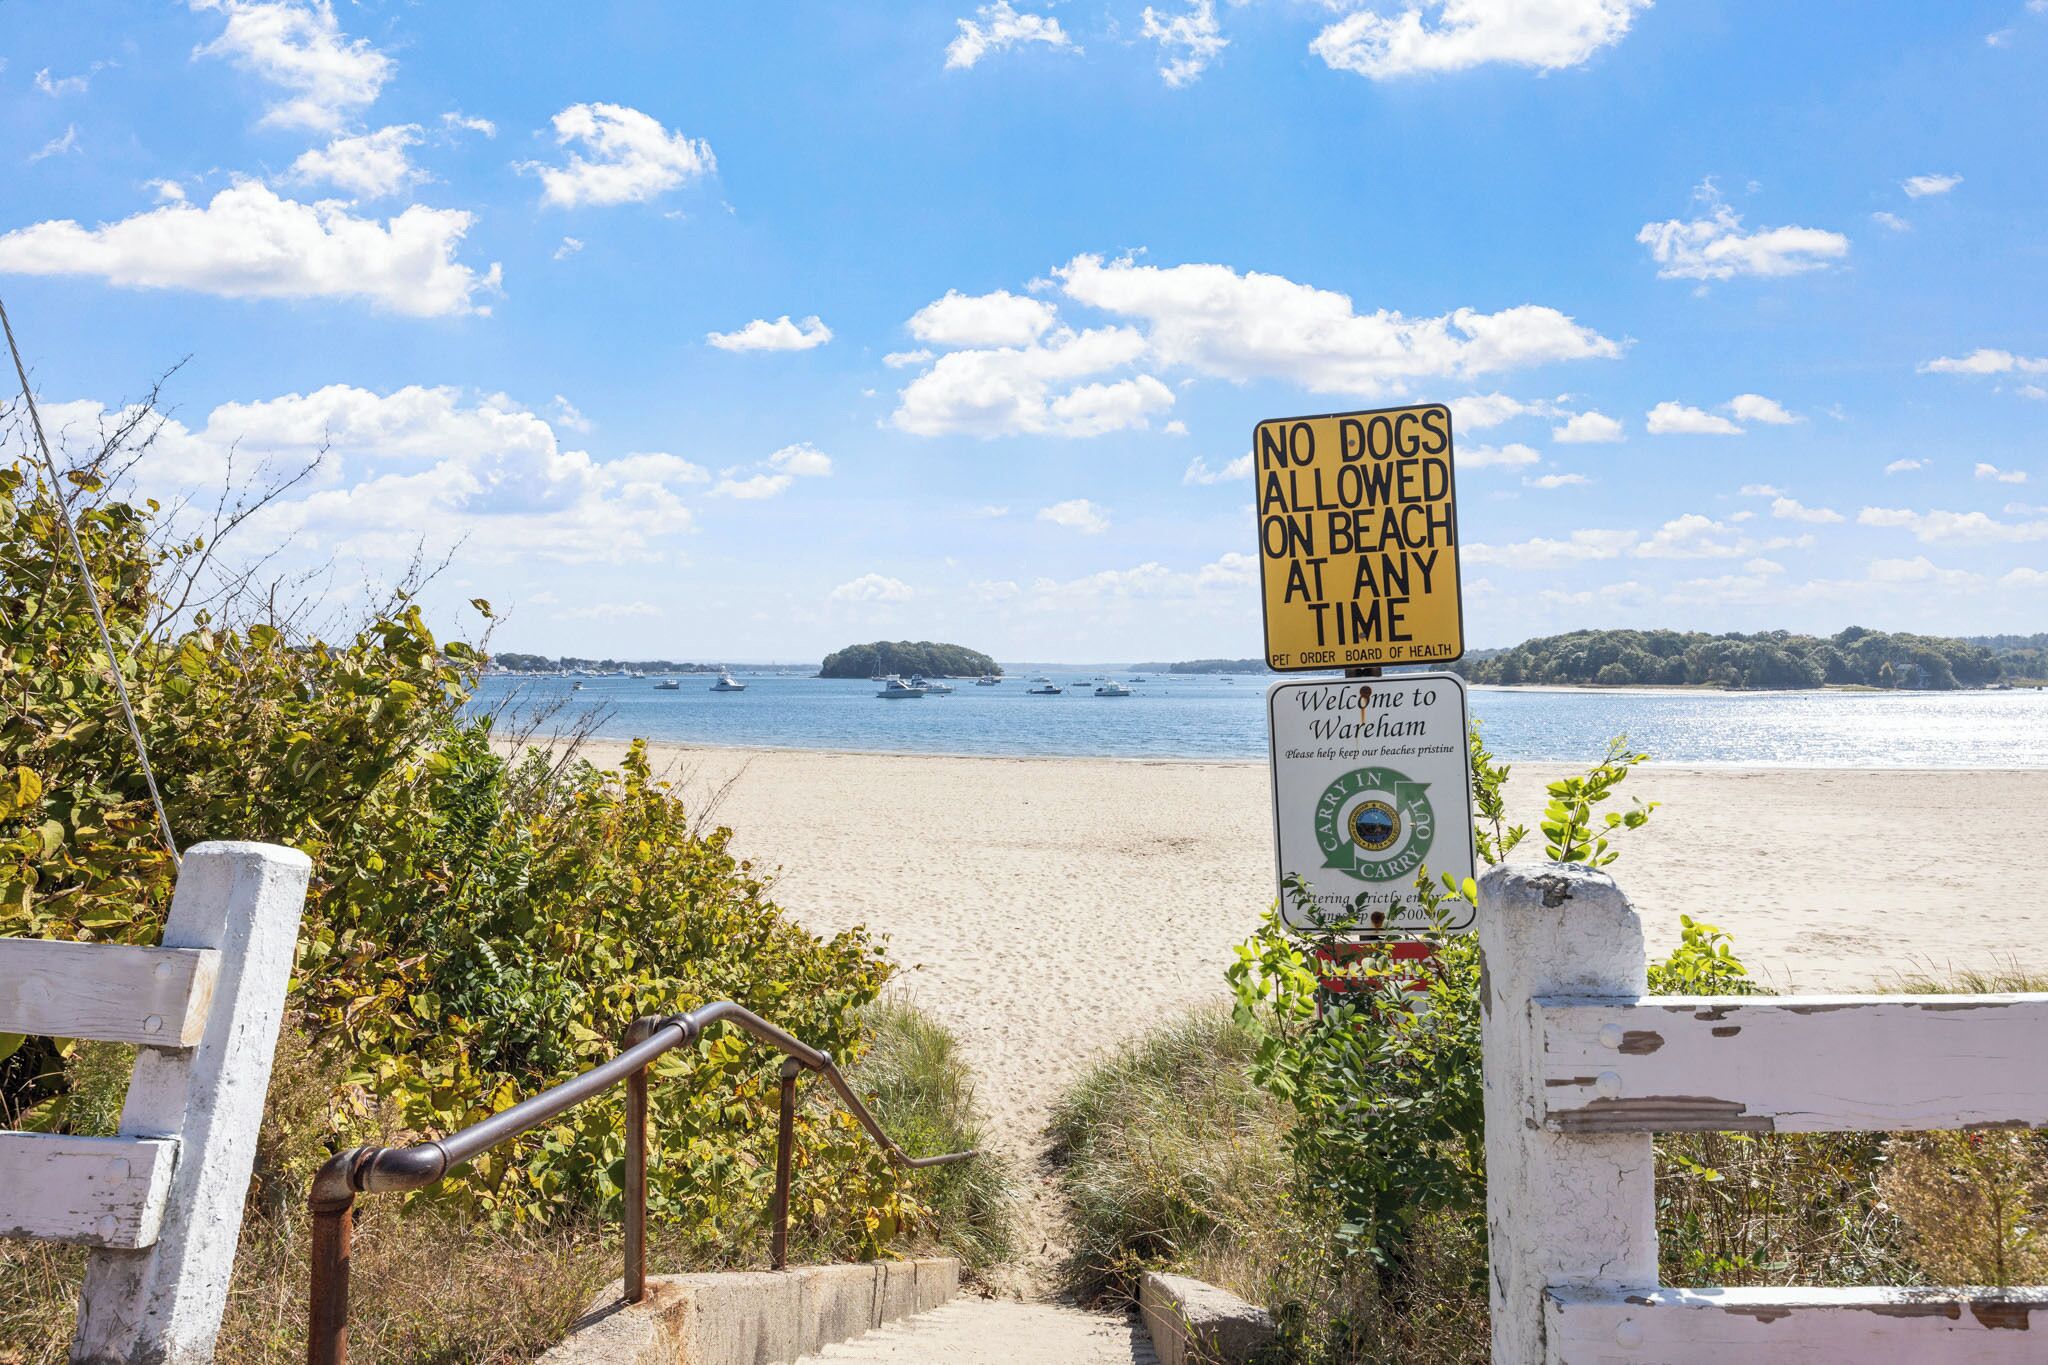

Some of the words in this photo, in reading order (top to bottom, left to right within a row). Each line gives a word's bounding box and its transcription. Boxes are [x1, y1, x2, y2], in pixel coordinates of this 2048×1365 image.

[1261, 422, 1315, 470] NO
[1340, 409, 1447, 462] DOGS
[1263, 458, 1449, 515] ALLOWED
[1263, 513, 1314, 559] ON
[1328, 503, 1454, 555] BEACH
[1284, 557, 1328, 604] AT
[1353, 550, 1438, 599] ANY
[1308, 597, 1412, 646] TIME
[1300, 651, 1336, 664] ORDER
[1345, 648, 1382, 662] BOARD
[1389, 646, 1404, 658] OF
[1409, 644, 1452, 657] HEALTH
[1295, 685, 1404, 712] Welcome
[1413, 687, 1437, 706] to
[1285, 748, 1314, 760] Please
[1316, 747, 1336, 760] help
[1338, 746, 1360, 760] keep
[1361, 748, 1377, 757] our
[1379, 745, 1415, 757] beaches
[1416, 744, 1454, 757] pristine
[1309, 713, 1426, 740] Wareham
[1319, 780, 1347, 853] CARRY
[1356, 772, 1382, 787] IN
[1360, 847, 1422, 878] CARRY
[1408, 798, 1431, 840] OUT
[1292, 892, 1350, 908] Ltering
